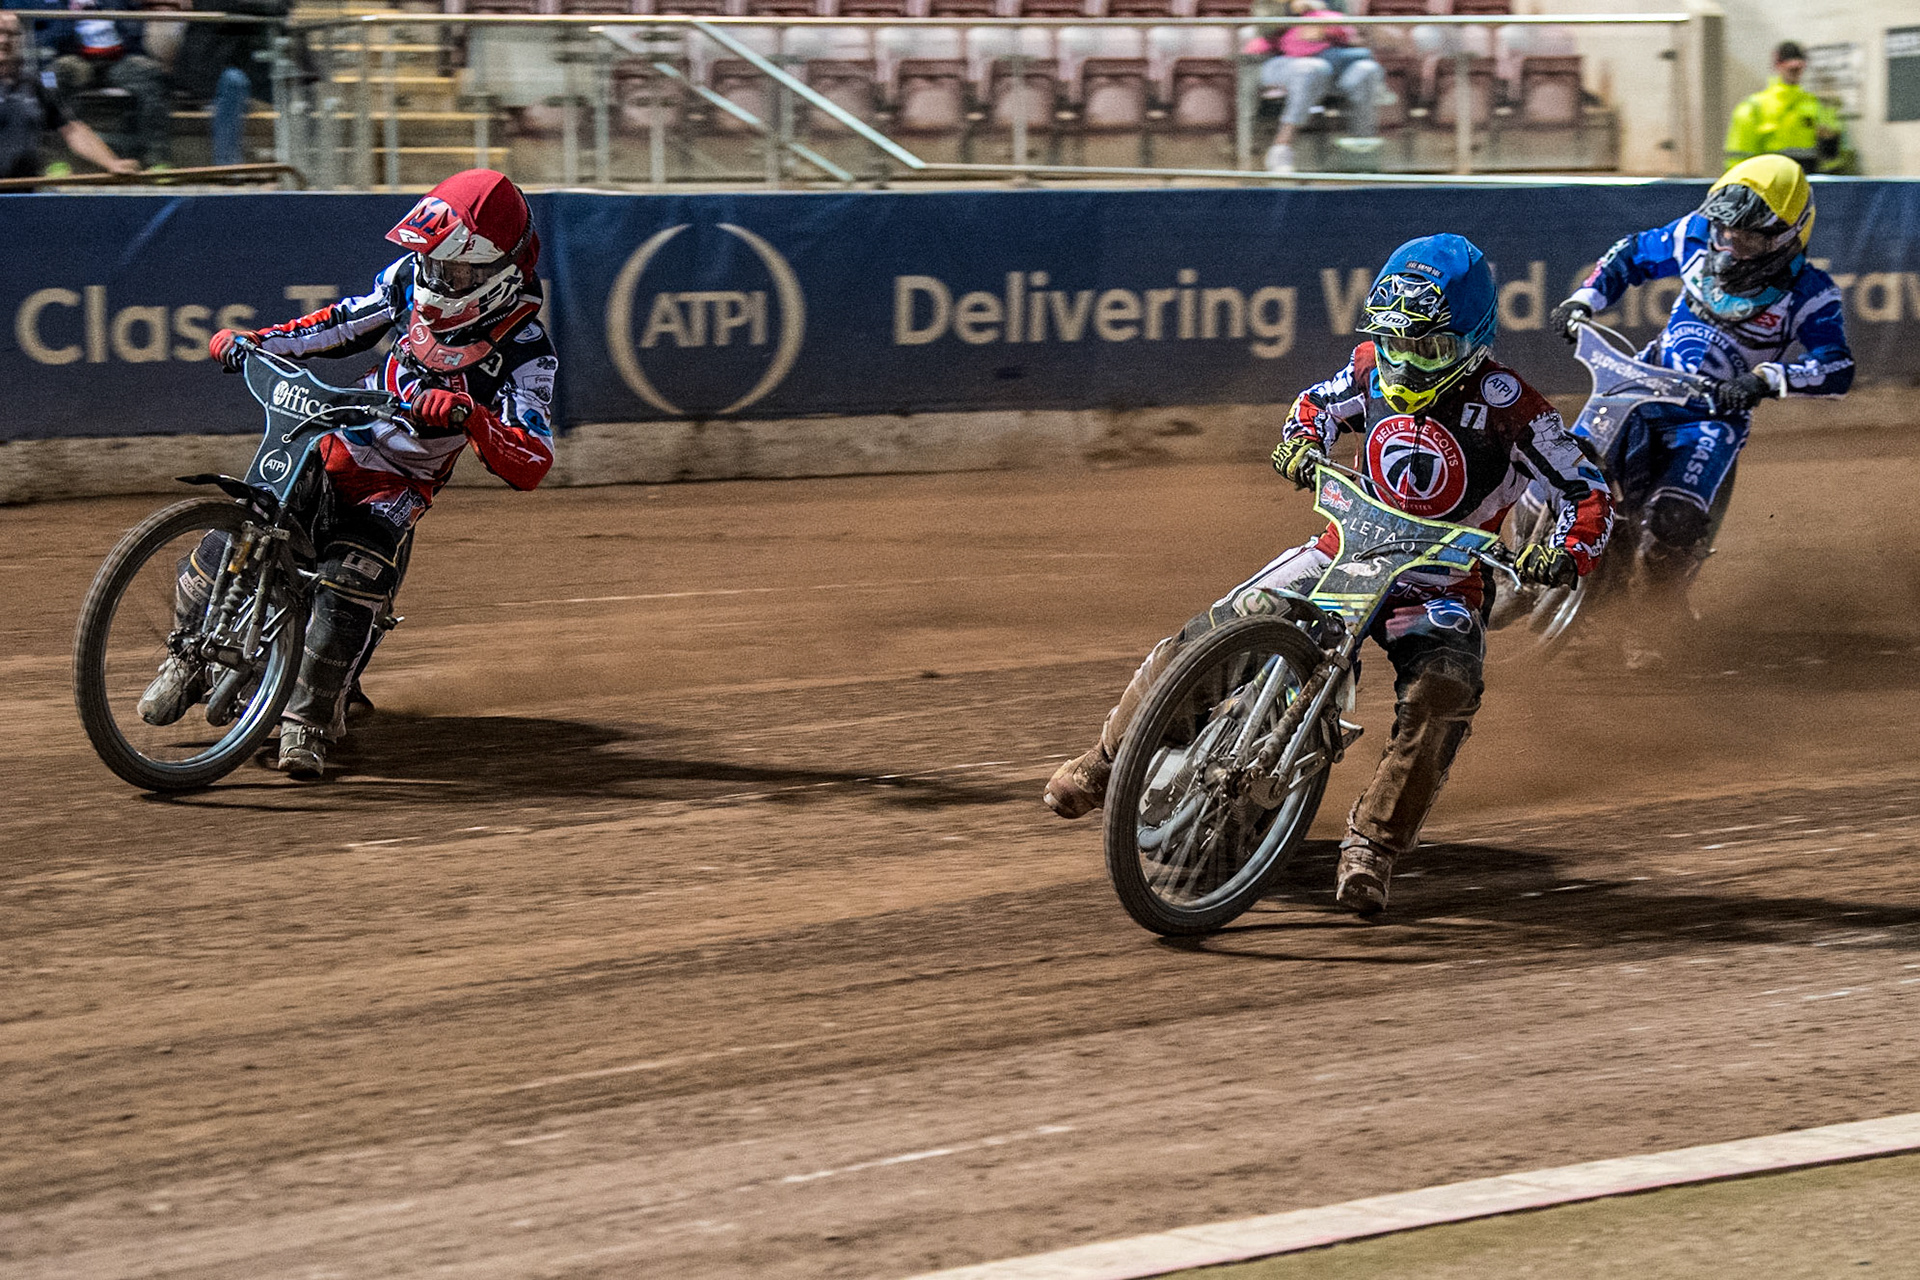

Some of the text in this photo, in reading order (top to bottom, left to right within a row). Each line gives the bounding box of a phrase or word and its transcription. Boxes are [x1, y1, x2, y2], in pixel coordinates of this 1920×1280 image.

[641, 291, 768, 347] ATPI
[893, 269, 1297, 358] Delivering
[1380, 314, 1406, 325] Arai
[1487, 377, 1513, 398] ATPI
[1467, 405, 1482, 429] 7
[1375, 421, 1405, 444] BELLE
[1433, 431, 1459, 467] COLTS
[265, 459, 287, 473] ATPI
[1357, 503, 1426, 539] TRENT
